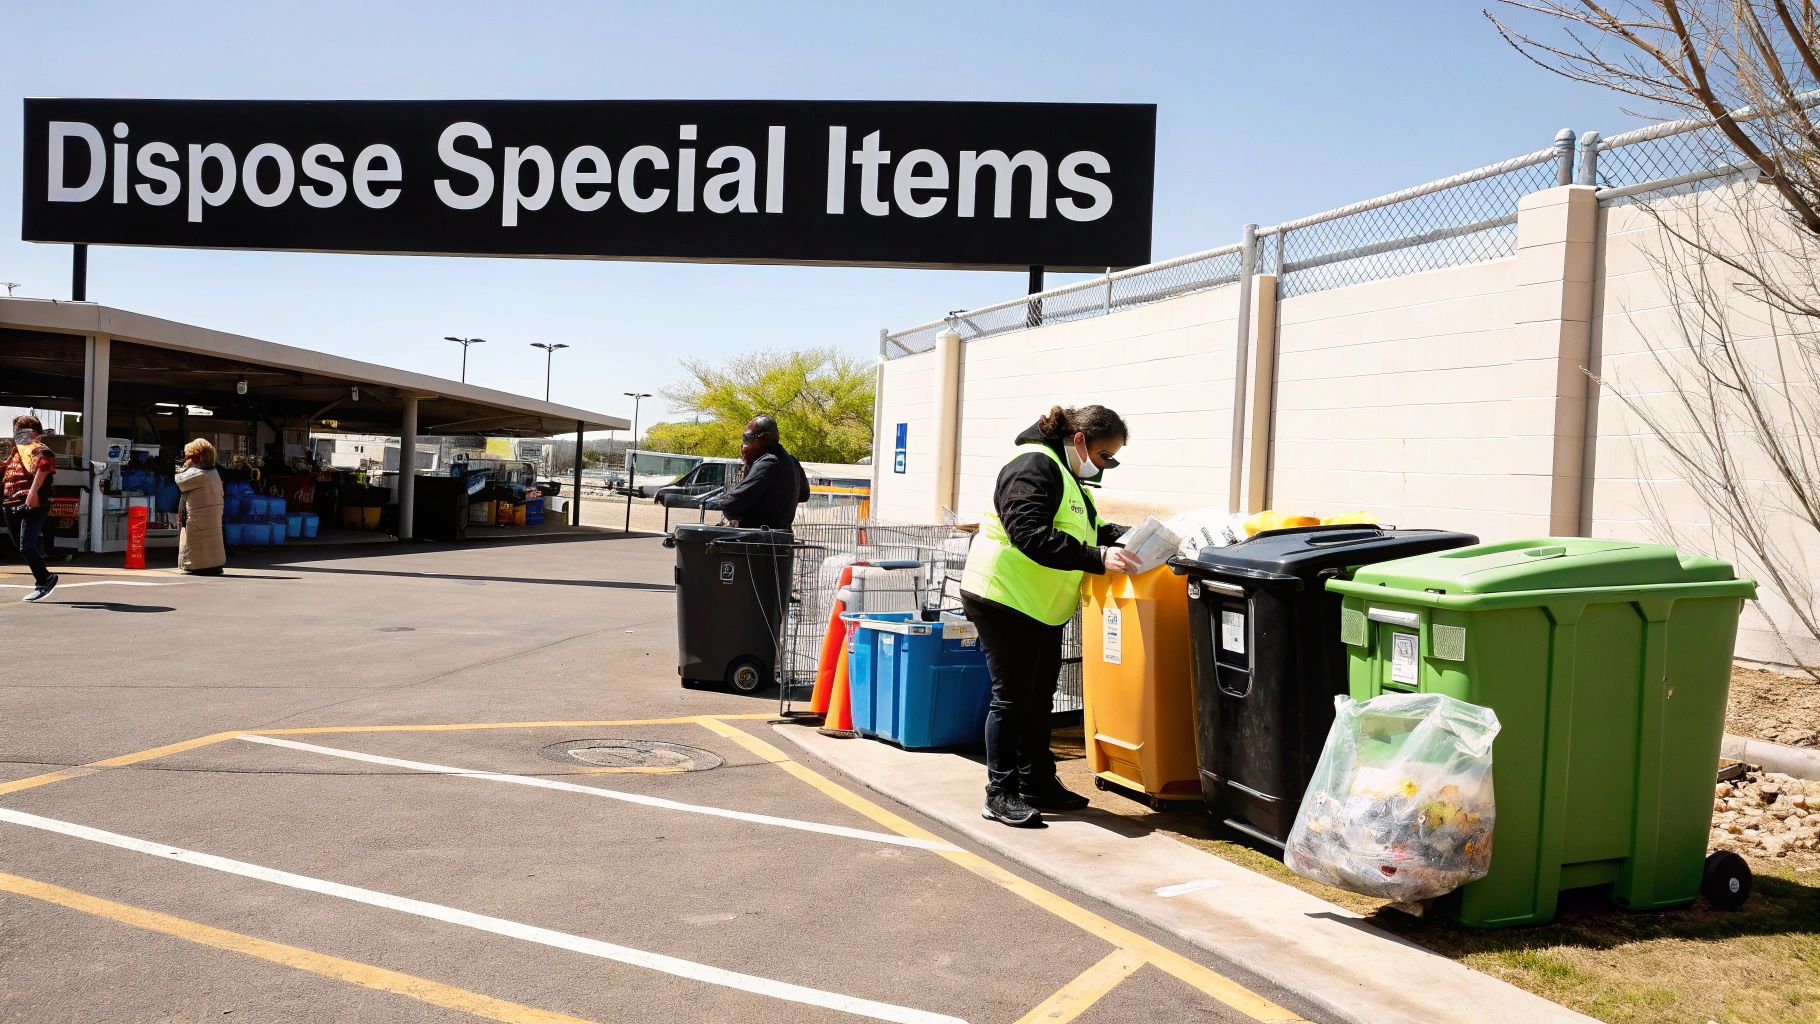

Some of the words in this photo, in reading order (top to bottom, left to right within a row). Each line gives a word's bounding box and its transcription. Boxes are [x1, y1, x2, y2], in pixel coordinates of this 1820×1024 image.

[47, 120, 403, 223] Dispose
[433, 121, 786, 227] Special
[826, 125, 1113, 222] Items
